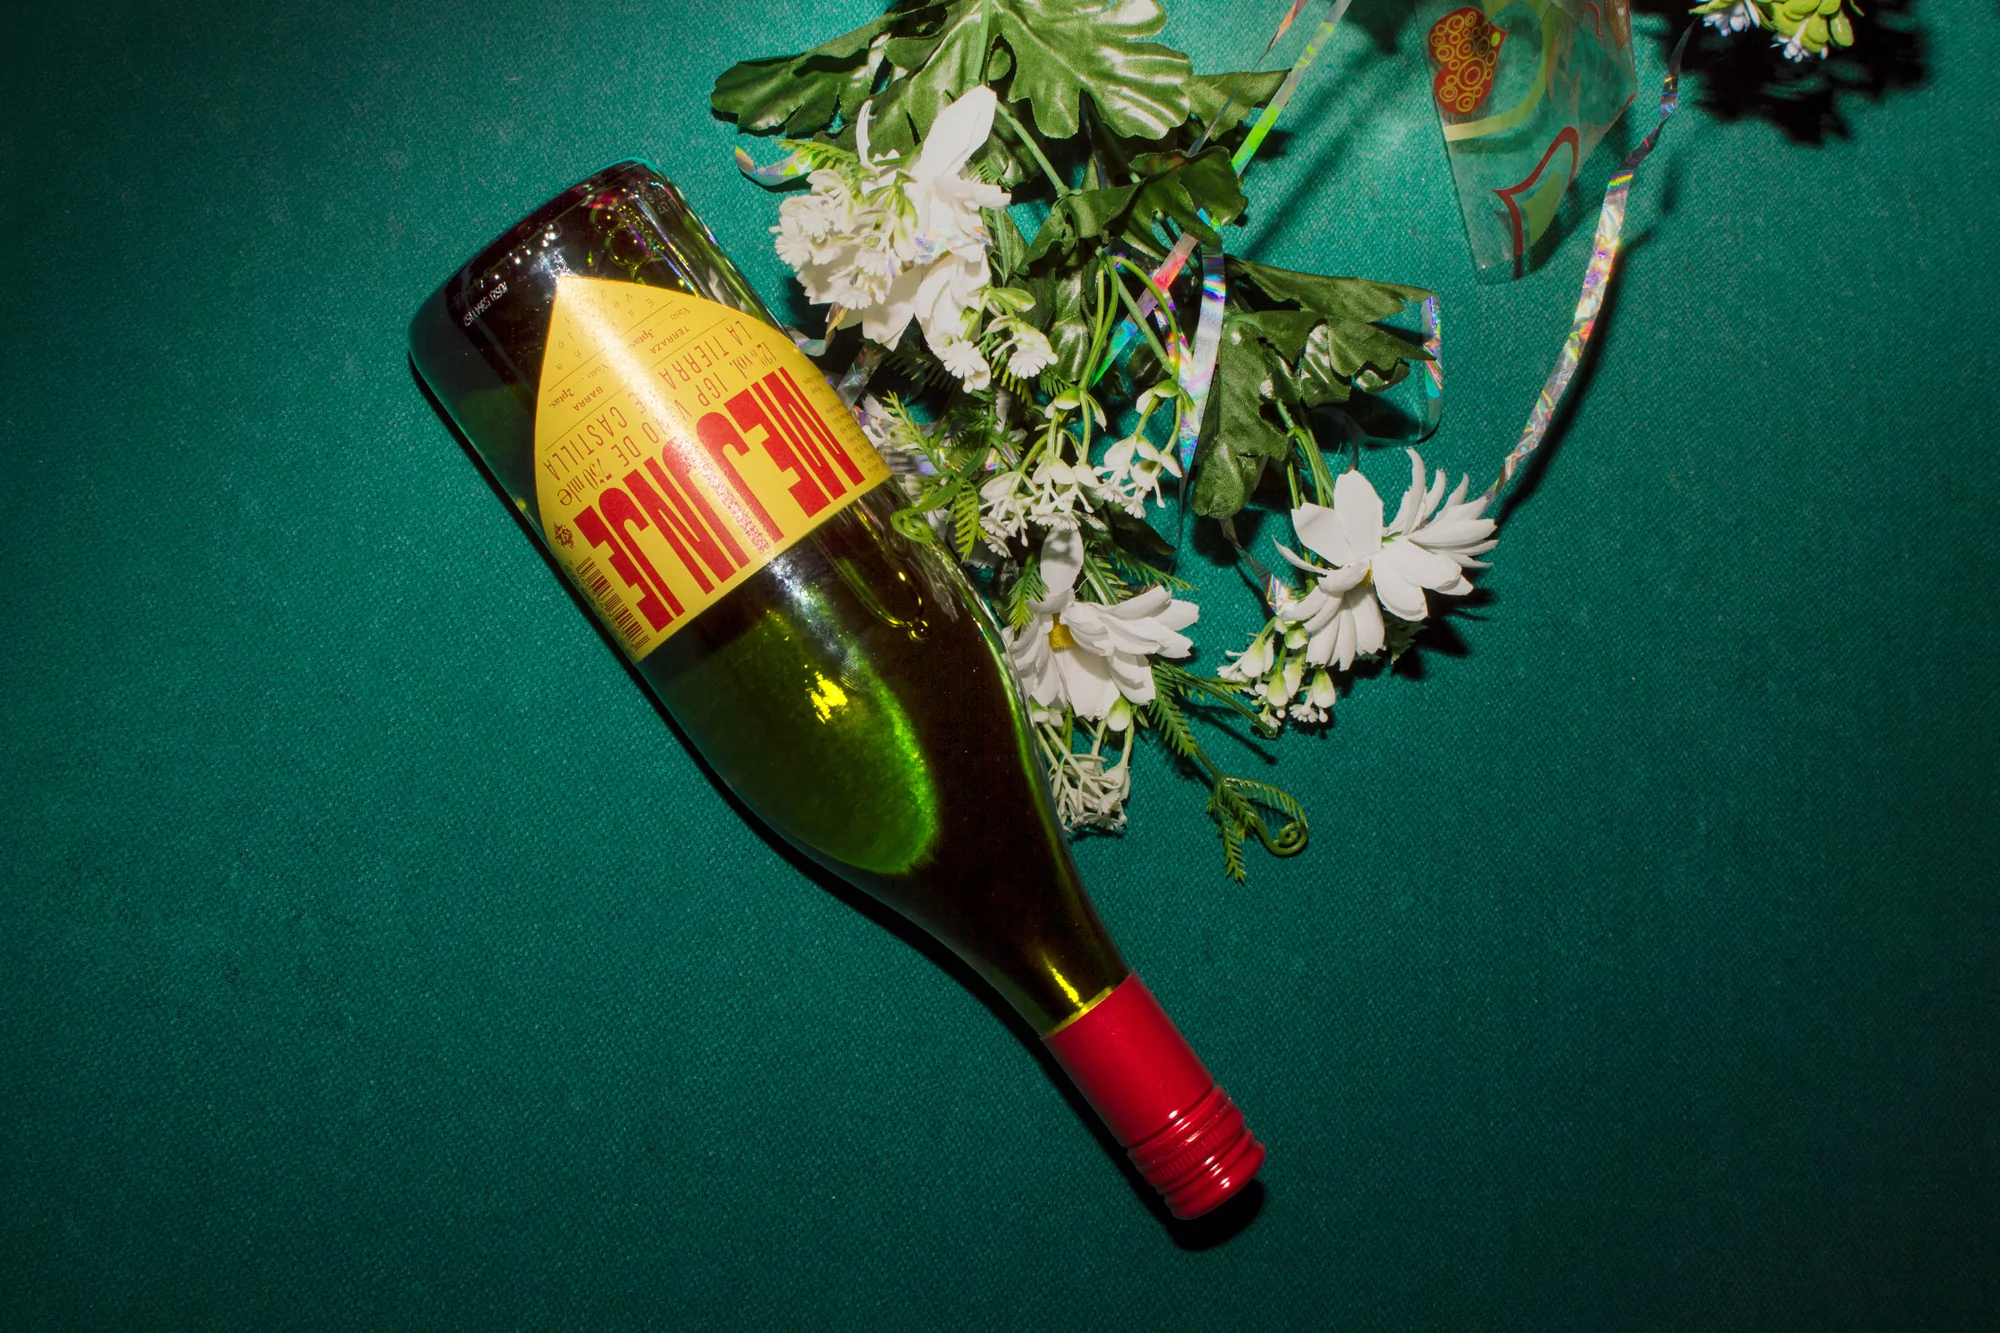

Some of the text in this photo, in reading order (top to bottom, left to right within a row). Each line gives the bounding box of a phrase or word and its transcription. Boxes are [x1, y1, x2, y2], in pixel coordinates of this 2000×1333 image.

[557, 292, 634, 350] Verejo
[649, 325, 690, 355] TERRAZA
[724, 320, 753, 346] LA
[658, 335, 730, 390] TIERRA
[572, 386, 604, 412] BARRA
[611, 371, 729, 468] IGP VO DE
[542, 406, 628, 482] CASTILLA
[573, 366, 866, 633] MEJUNJE
[582, 458, 613, 491] 750
